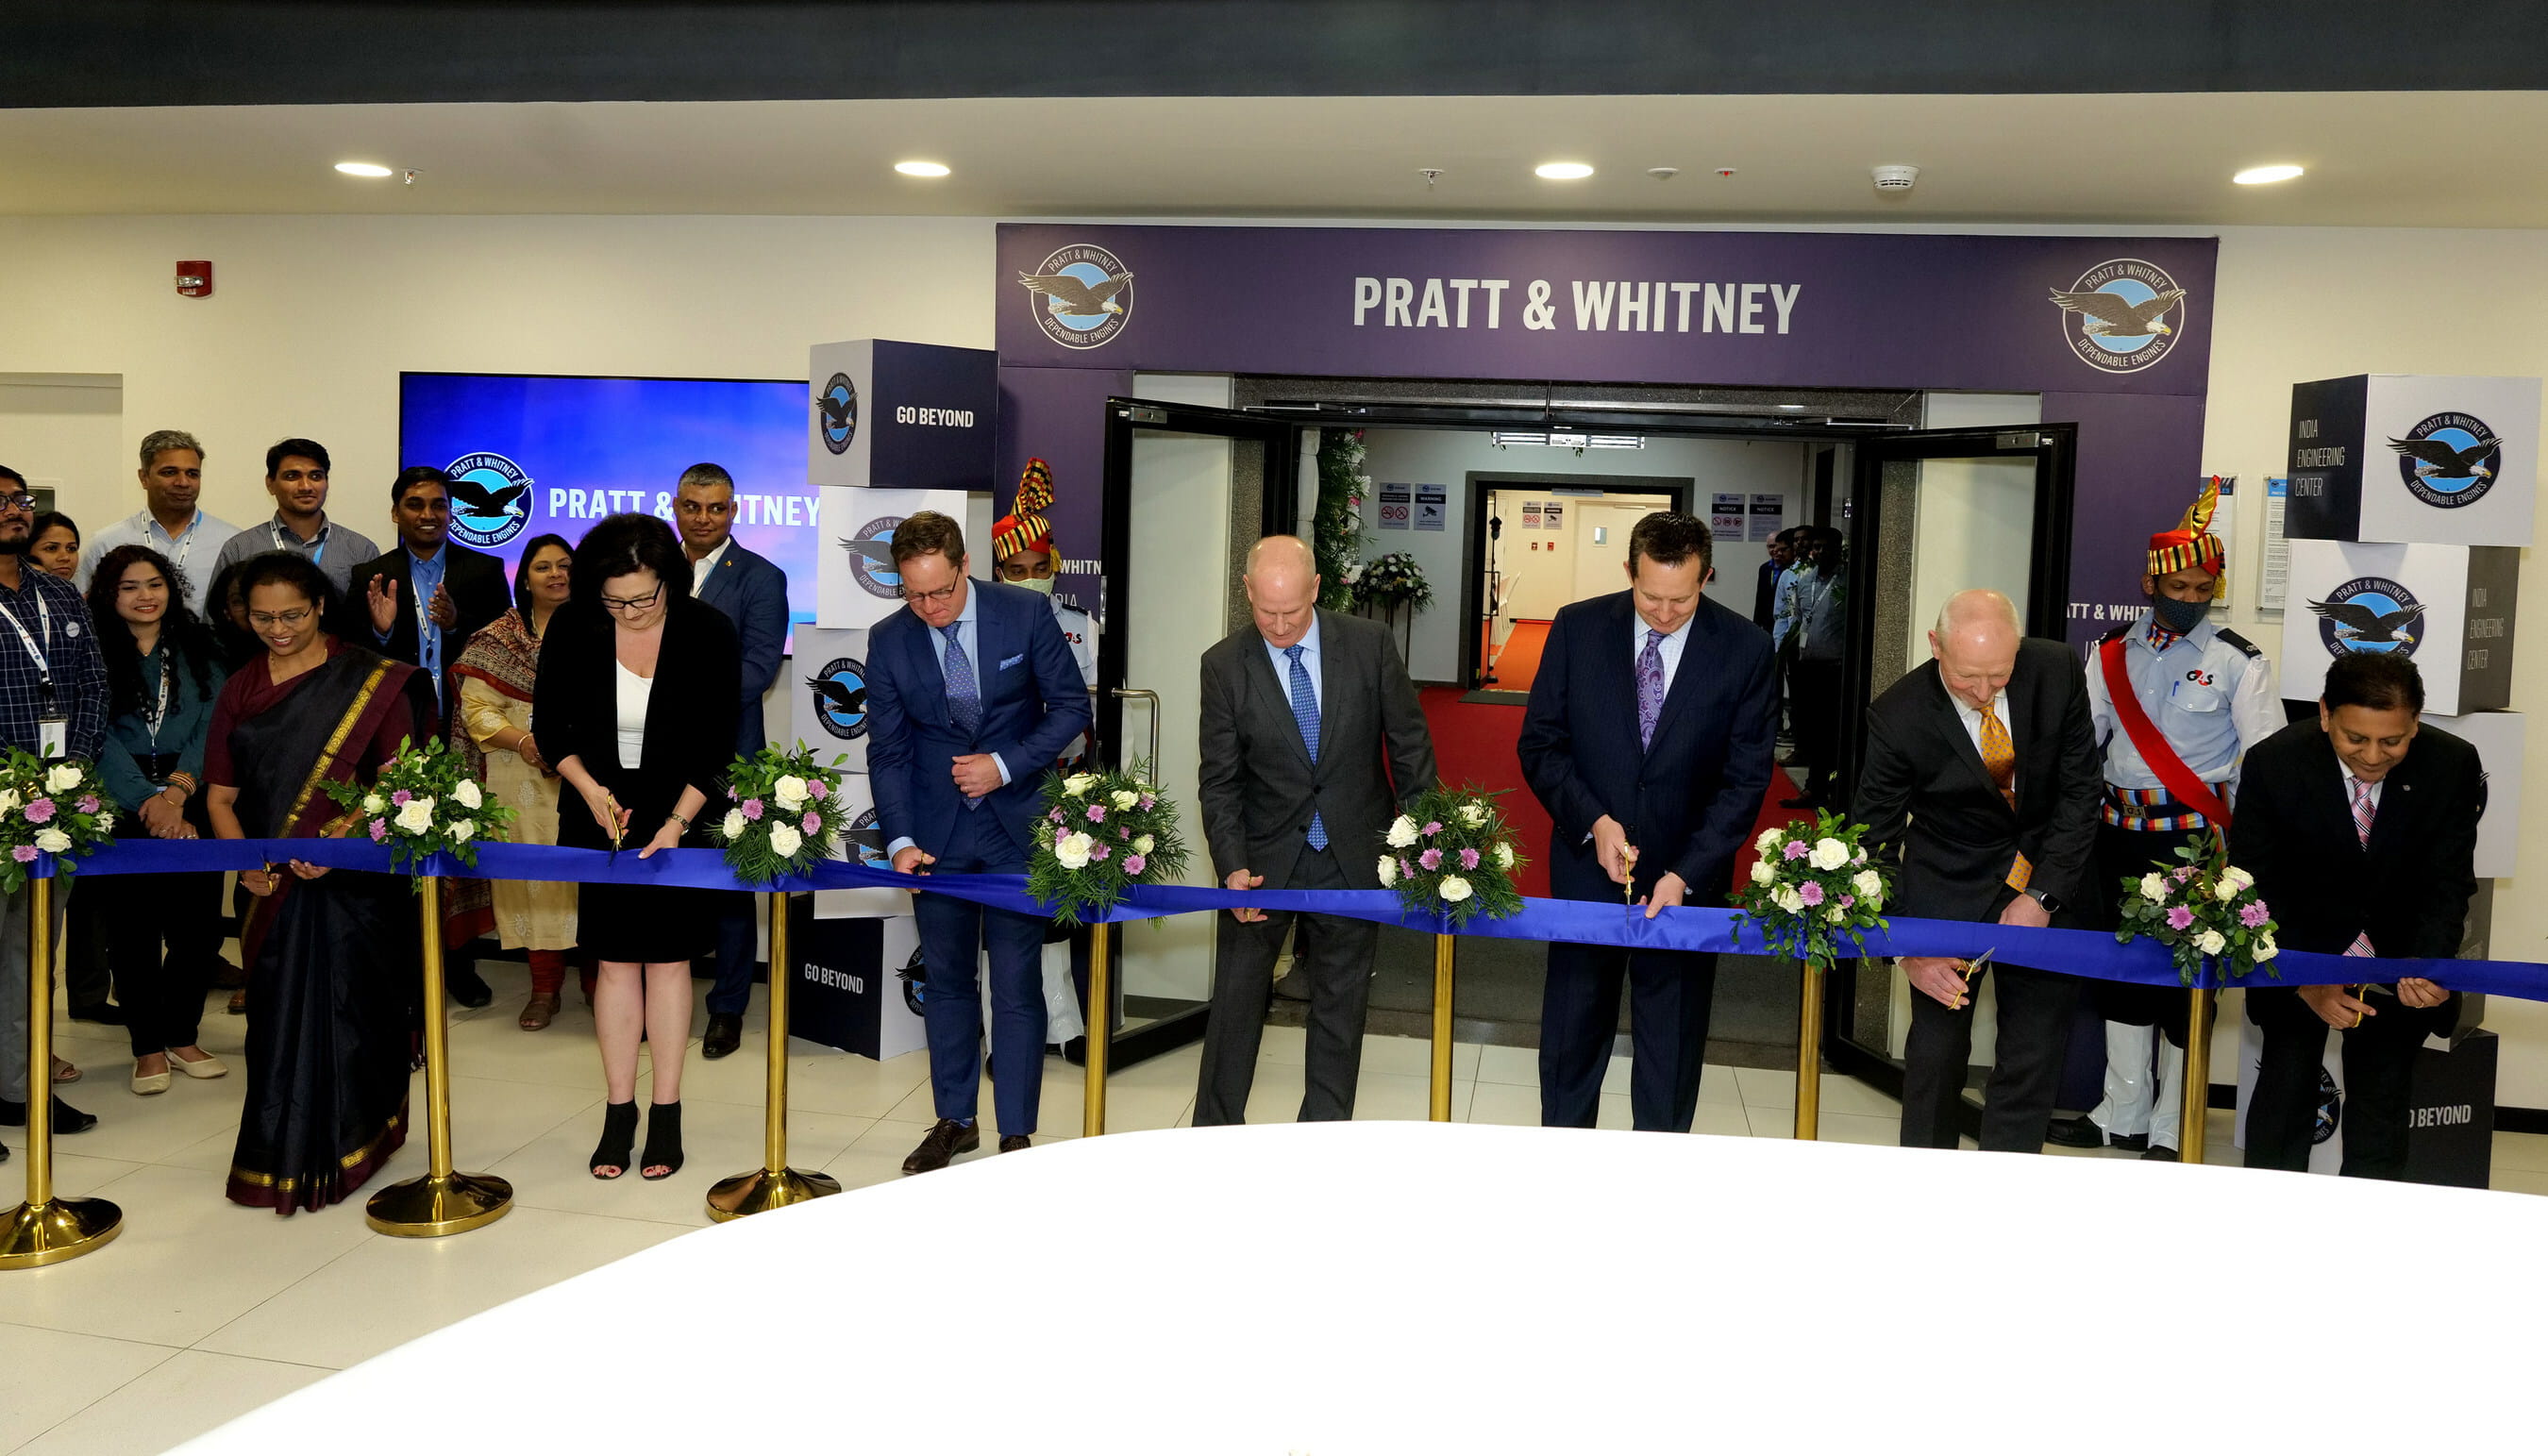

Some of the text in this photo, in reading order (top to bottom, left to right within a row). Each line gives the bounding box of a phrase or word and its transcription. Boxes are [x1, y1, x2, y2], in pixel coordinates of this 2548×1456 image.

[1048, 249, 1117, 272] PRATT & WHITNEY
[2085, 263, 2168, 289] PRATT & WHITNEY
[1353, 276, 1802, 335] PRATT & WHITNEY
[1045, 317, 1118, 343] DEPENDABLE ENGINES
[2078, 338, 2166, 367] DEPENDABLE ENGINES
[897, 406, 974, 428] GO BEYOND
[2416, 415, 2489, 438] PRATT & WHITNEY
[2299, 419, 2318, 439] INDIA
[450, 457, 519, 479] PRATT & WHITNEY
[2297, 446, 2345, 468] ENGINEERING
[2294, 477, 2323, 496] CENTER
[2410, 479, 2488, 505] DEPENDABLE ENGINES
[549, 488, 820, 527] PRATT & ITNEY
[492, 521, 520, 543] ENGINES
[863, 520, 884, 537] PRATT
[1060, 560, 1102, 575] WHITN
[860, 574, 897, 596] DEPENDABLE
[2336, 579, 2411, 603] PRATT & WHITNEY
[2093, 604, 2104, 620] &
[2109, 604, 2151, 622] WHIT
[824, 661, 841, 678] PRATT
[842, 661, 847, 669] &
[2187, 669, 2214, 686] G4S
[821, 713, 849, 736] DEPENDABLE
[859, 811, 877, 827] PRAT
[805, 962, 863, 995] GO BEYOND
[2417, 1104, 2472, 1128] BEYOND
